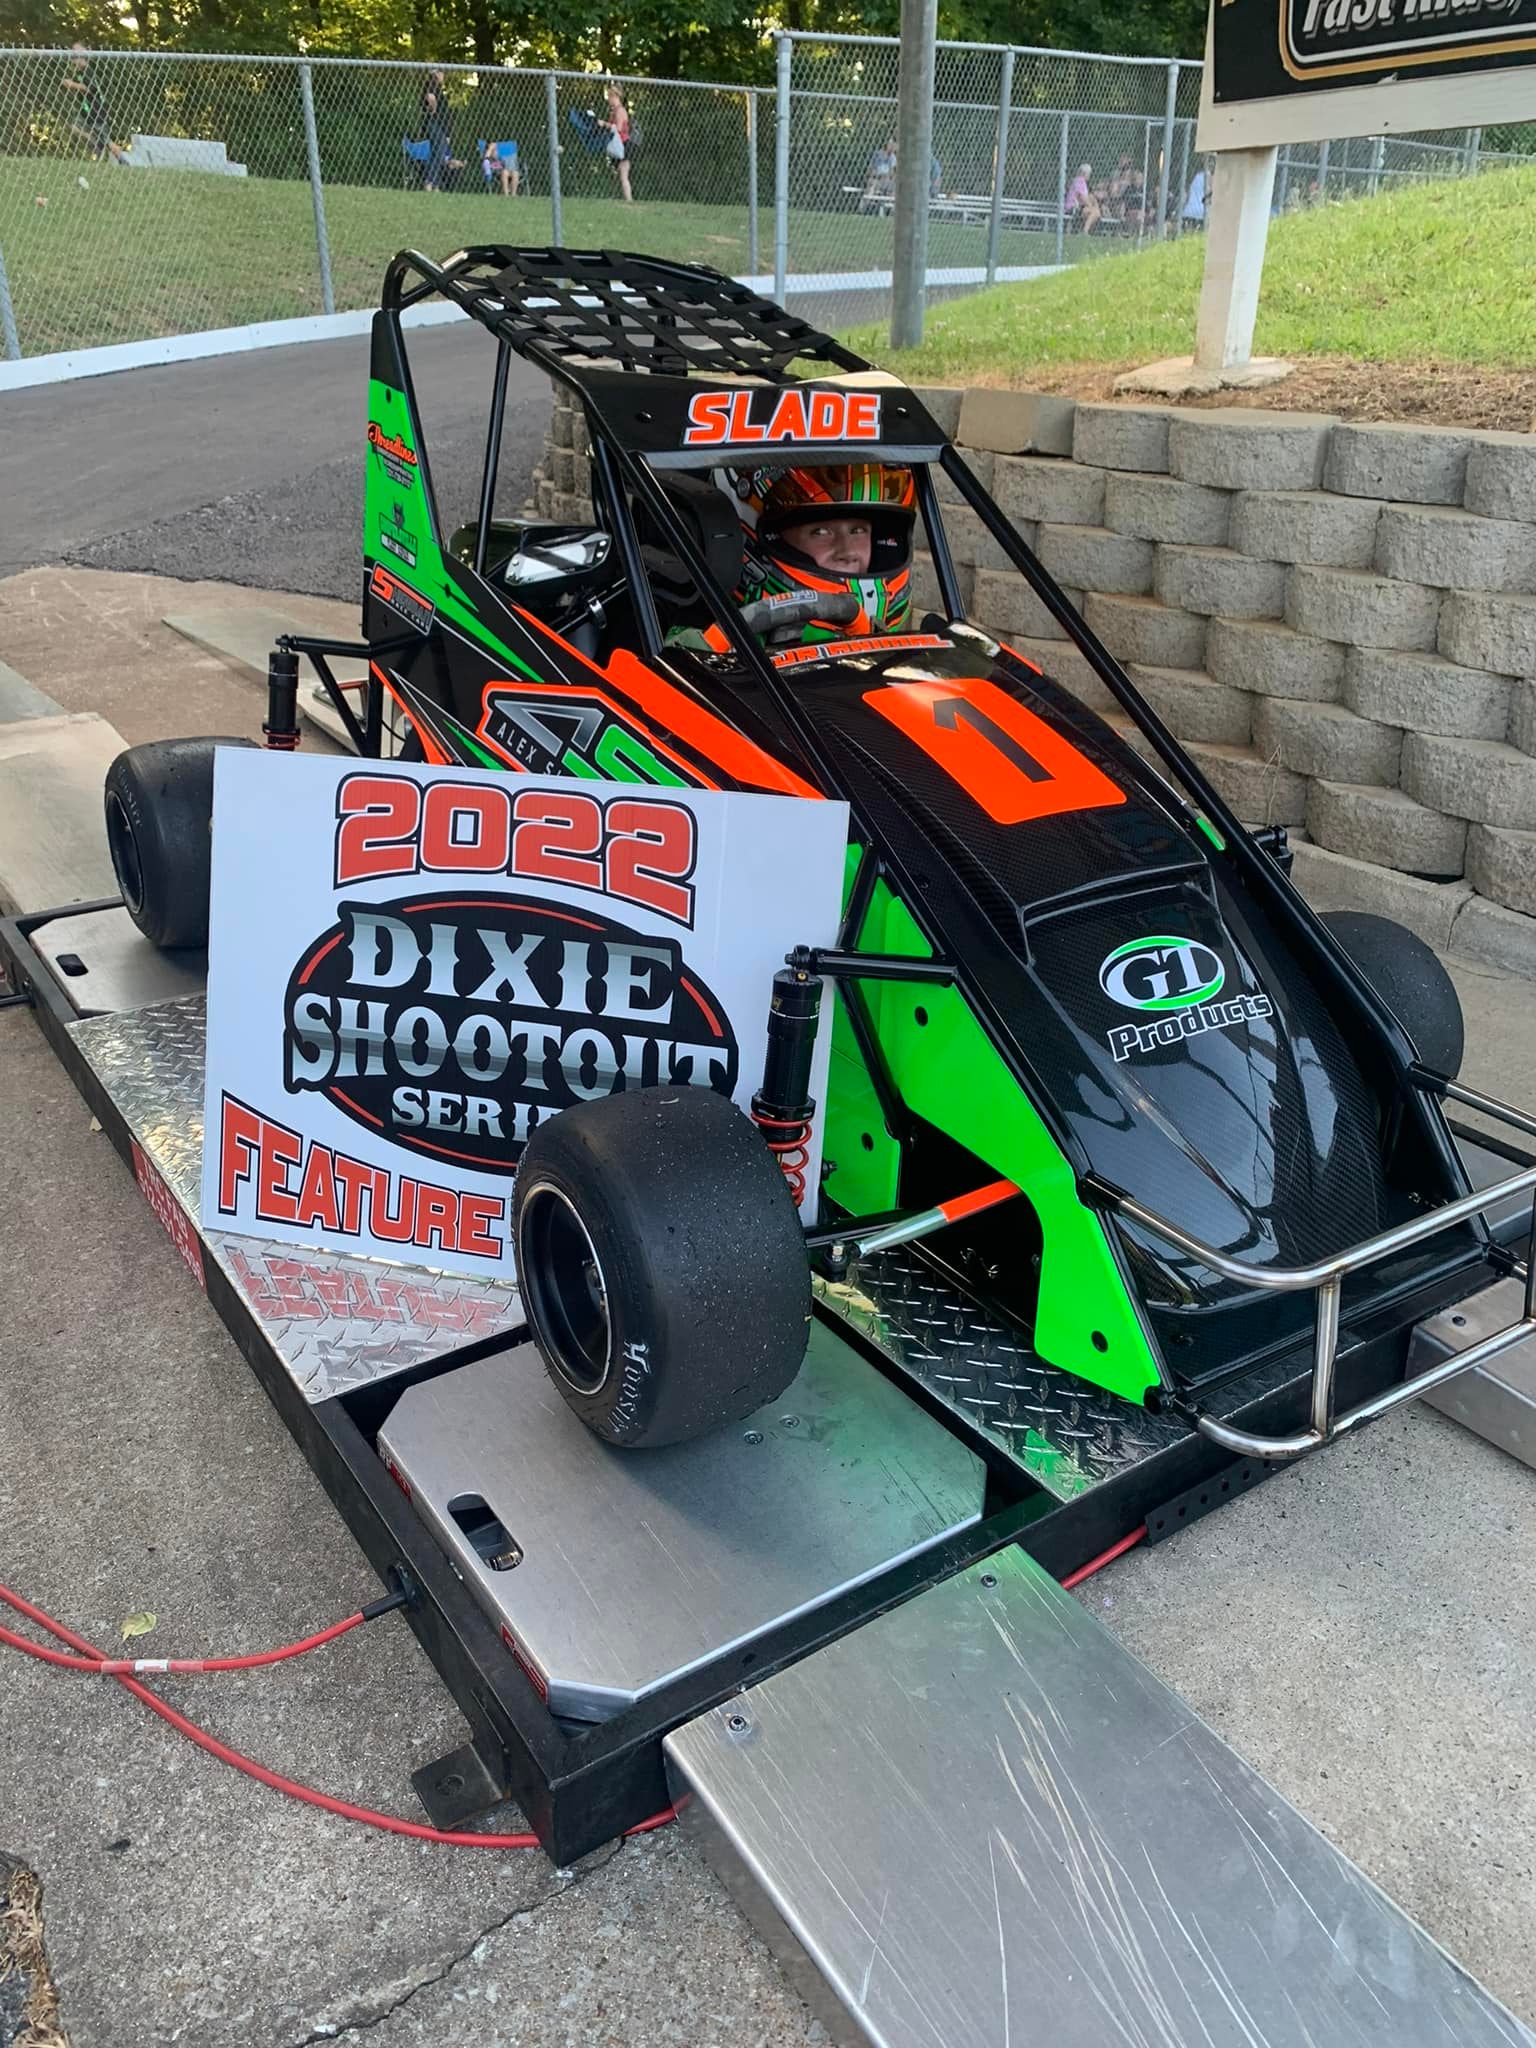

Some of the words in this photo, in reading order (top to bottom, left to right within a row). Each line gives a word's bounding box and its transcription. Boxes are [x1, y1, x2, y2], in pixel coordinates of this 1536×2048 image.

[683, 390, 882, 445] SLADE
[496, 722, 539, 764] ALEX
[933, 697, 1056, 783] 1
[334, 772, 698, 931] 2022
[347, 912, 674, 1025] DIXIE
[1106, 946, 1209, 1004] GT
[293, 993, 729, 1101] SHOOTOUT
[1107, 994, 1274, 1062] Products
[219, 1090, 504, 1260] FEATURE
